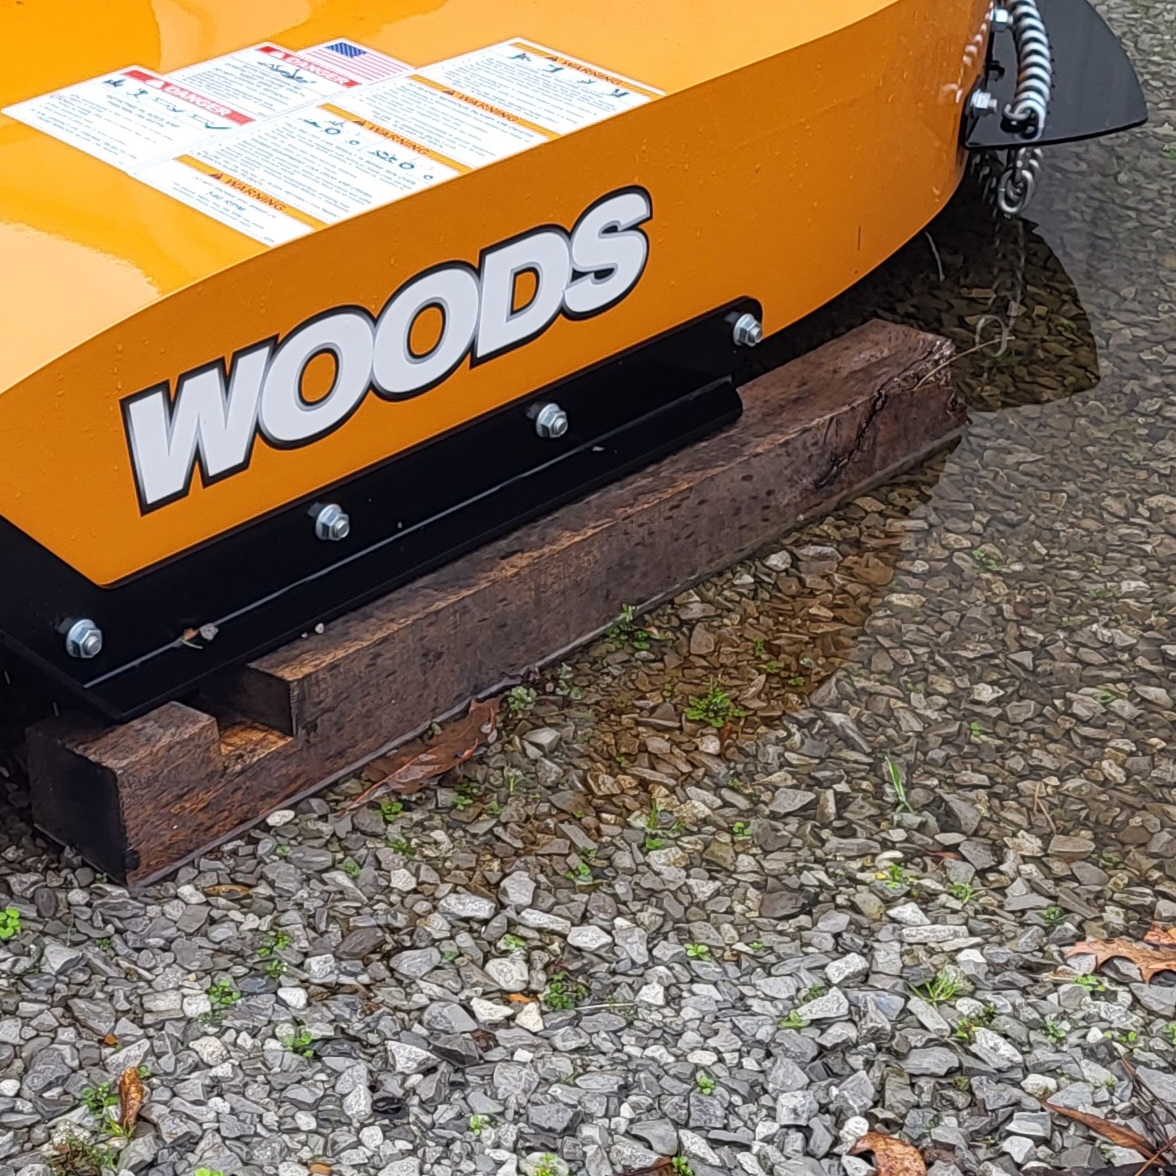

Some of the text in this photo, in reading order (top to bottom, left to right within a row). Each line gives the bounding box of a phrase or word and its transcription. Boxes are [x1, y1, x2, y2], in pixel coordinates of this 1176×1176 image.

[287, 56, 346, 86] DANGER
[562, 59, 624, 86] WARNING
[162, 83, 232, 116] DANGER
[458, 93, 519, 122] WARNING
[368, 124, 431, 156] WARNING
[225, 178, 286, 211] WARNING
[122, 187, 652, 512] WOODS
